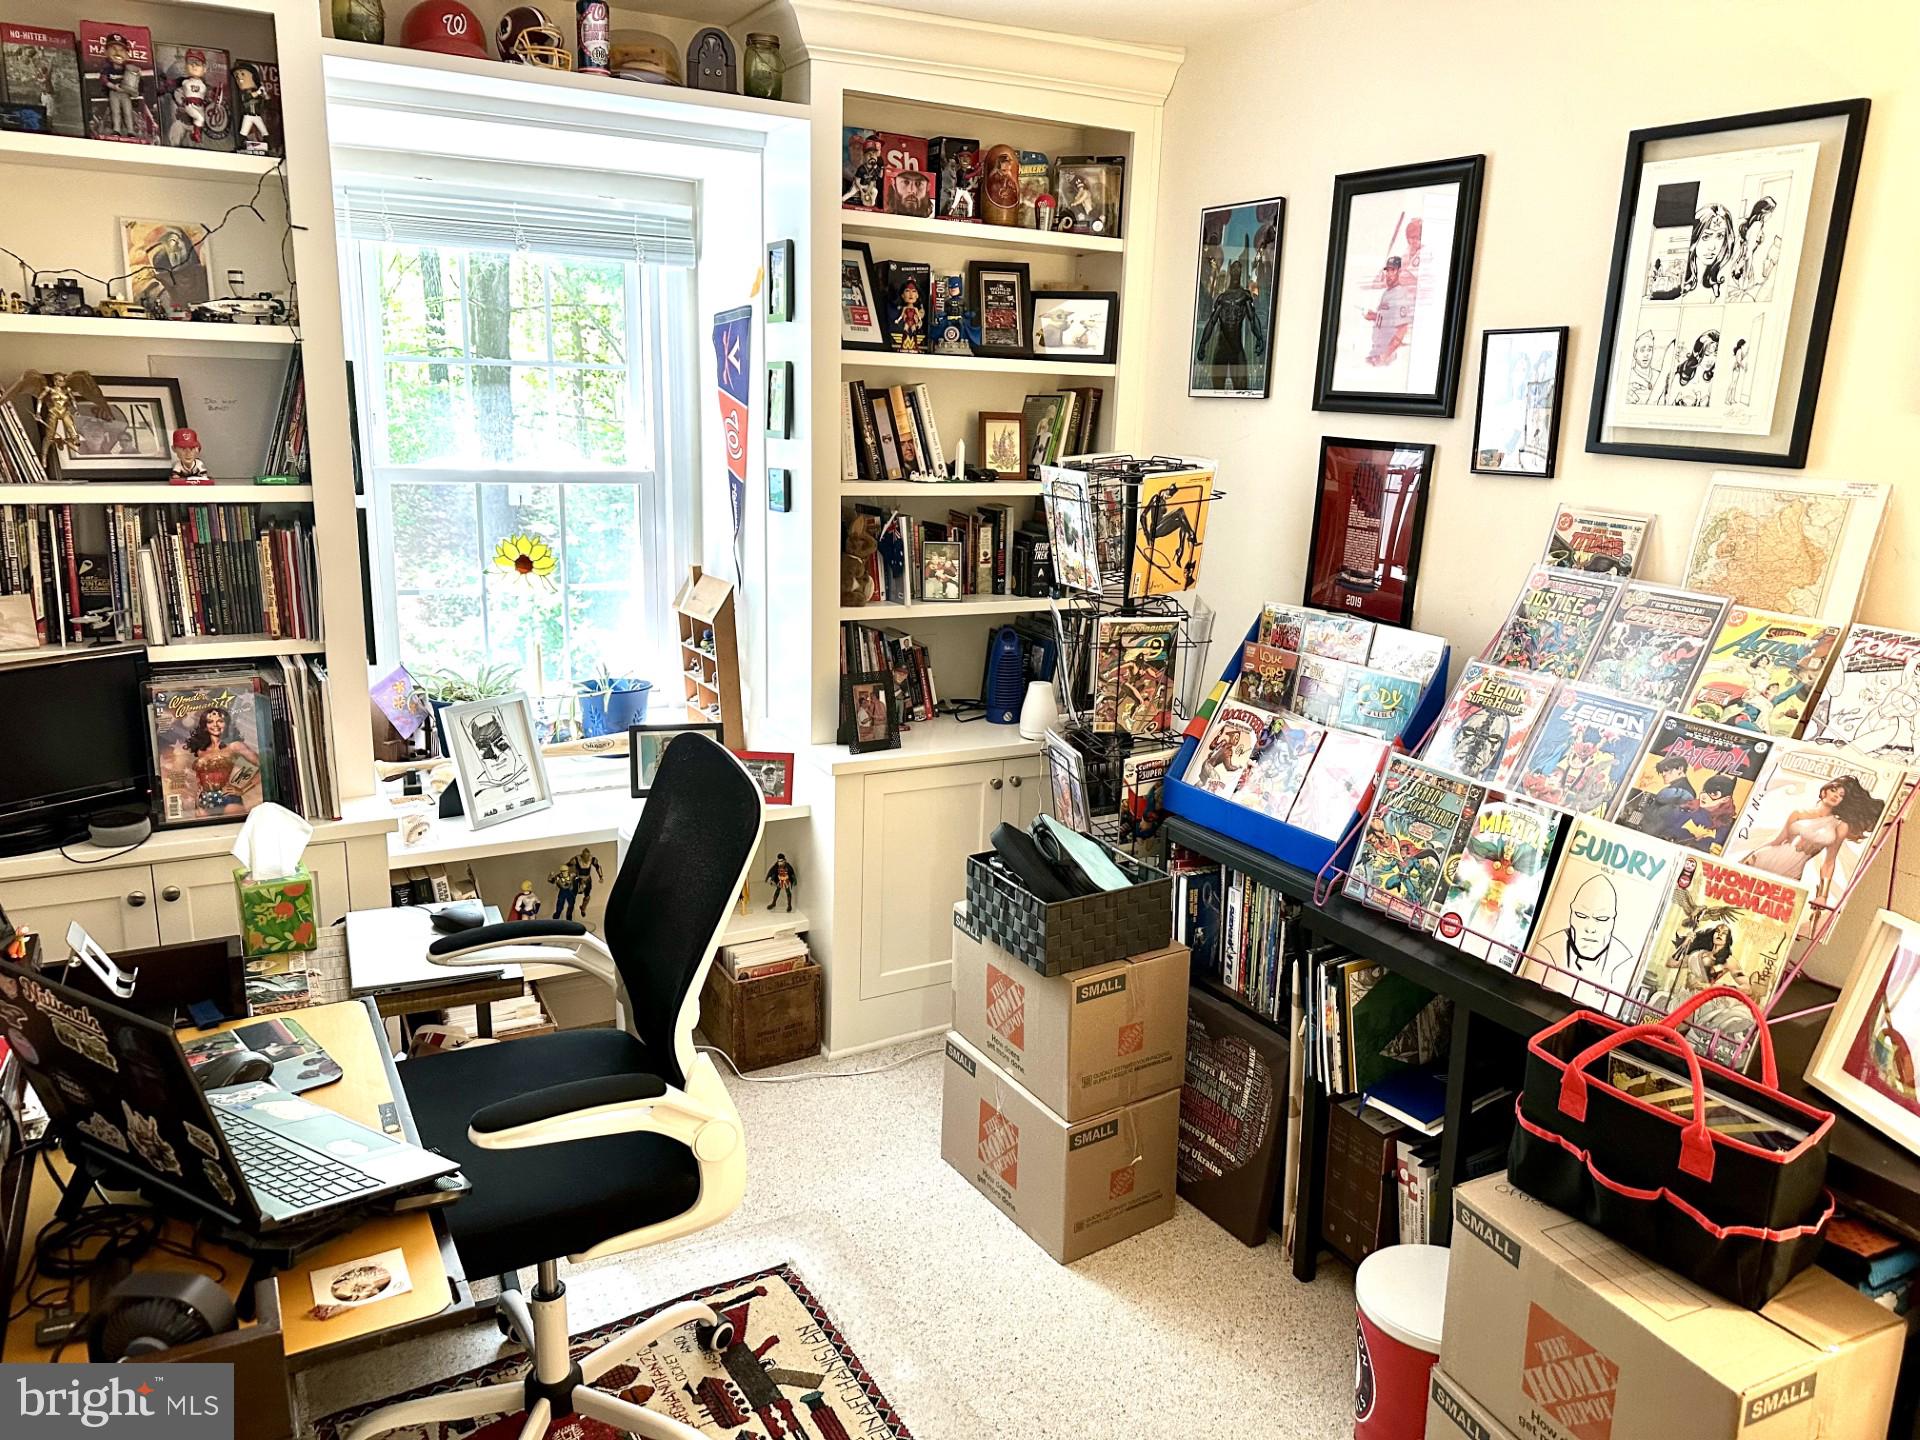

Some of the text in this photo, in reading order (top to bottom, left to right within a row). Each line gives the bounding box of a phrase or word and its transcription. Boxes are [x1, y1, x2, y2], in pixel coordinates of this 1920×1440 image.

[10, 30, 47, 42] NO-HITTER
[89, 44, 147, 61] MANEZ
[1034, 551, 1048, 560] TREK
[1346, 594, 1362, 608] 2019
[1523, 590, 1586, 615] JUSTICE
[1537, 608, 1594, 629] SOCIETY
[1712, 624, 1806, 660] ACTION
[1477, 680, 1528, 702] LEGION
[1564, 702, 1645, 733] LEGION
[1684, 723, 1712, 735] SUMMER
[1724, 733, 1739, 742] LIES
[1664, 736, 1750, 776] BATGIRL
[1781, 753, 1829, 776] WONDER
[483, 807, 498, 818] MAD
[1568, 829, 1667, 881] GUIDRY
[1702, 861, 1797, 906] WONDER
[1705, 880, 1794, 924] WOMAN
[955, 914, 980, 940] SMALL
[990, 979, 1006, 998] THE
[1080, 978, 1122, 999] SMALL
[986, 983, 1025, 1028] HOME
[1000, 1009, 1025, 1039] DEPOT
[991, 1033, 1004, 1049] How
[946, 1045, 975, 1073] SMALL
[1218, 1070, 1242, 1093] Rose
[982, 1116, 997, 1135] THE
[1073, 1125, 1114, 1147] SMALL
[978, 1120, 1019, 1164] HOME
[1206, 1134, 1236, 1163] Mexico
[992, 1150, 1018, 1176] DEPOT
[1191, 1148, 1223, 1178] Ukraine
[1459, 1206, 1515, 1261] SMALL
[1534, 1336, 1572, 1363] THE
[1523, 1352, 1617, 1405] HOME
[1436, 1388, 1485, 1440] SMALL
[1555, 1396, 1612, 1426] DEPOT
[1749, 1381, 1810, 1421] SMALL
[1518, 1415, 1538, 1435] get
[1531, 1409, 1558, 1438] How
